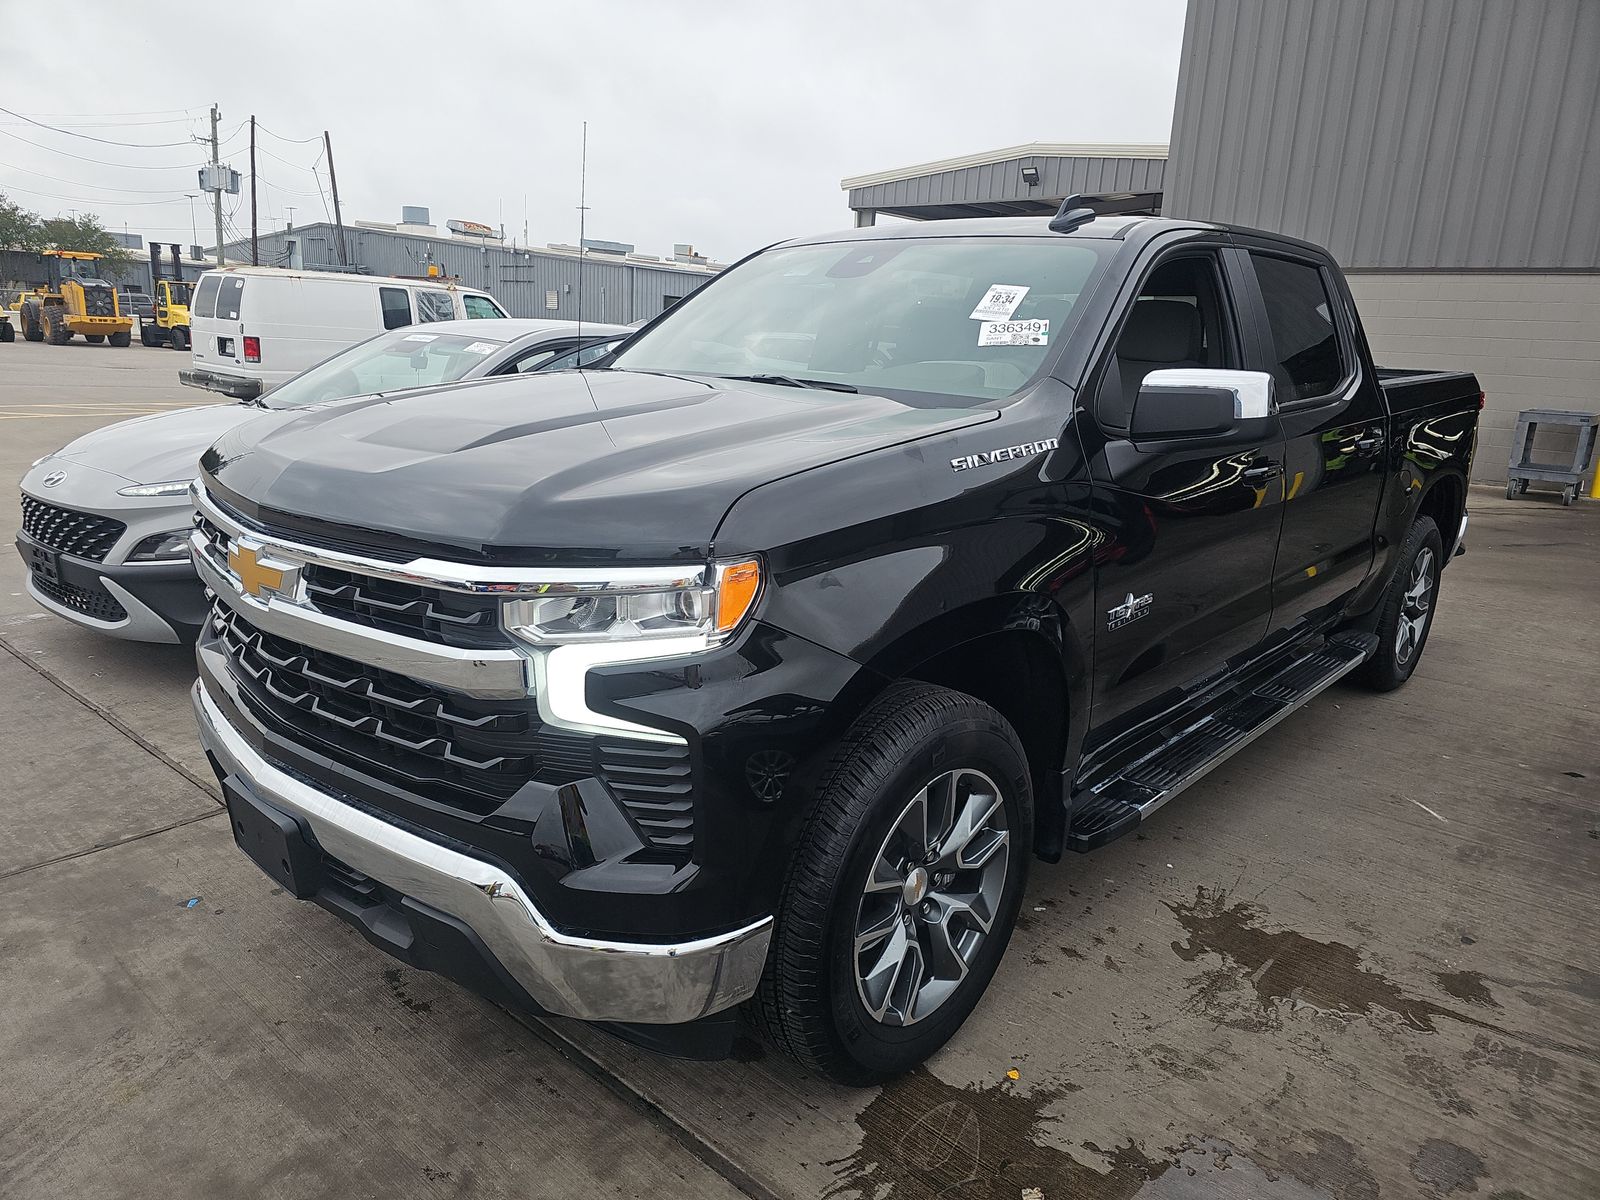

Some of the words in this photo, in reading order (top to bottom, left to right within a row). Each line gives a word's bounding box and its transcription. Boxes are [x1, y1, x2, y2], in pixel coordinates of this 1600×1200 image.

[990, 294, 1015, 304] 19:34
[989, 322, 1048, 333] 3363491
[951, 438, 1059, 472] SILVERADO
[1107, 593, 1153, 620] TEXAS
